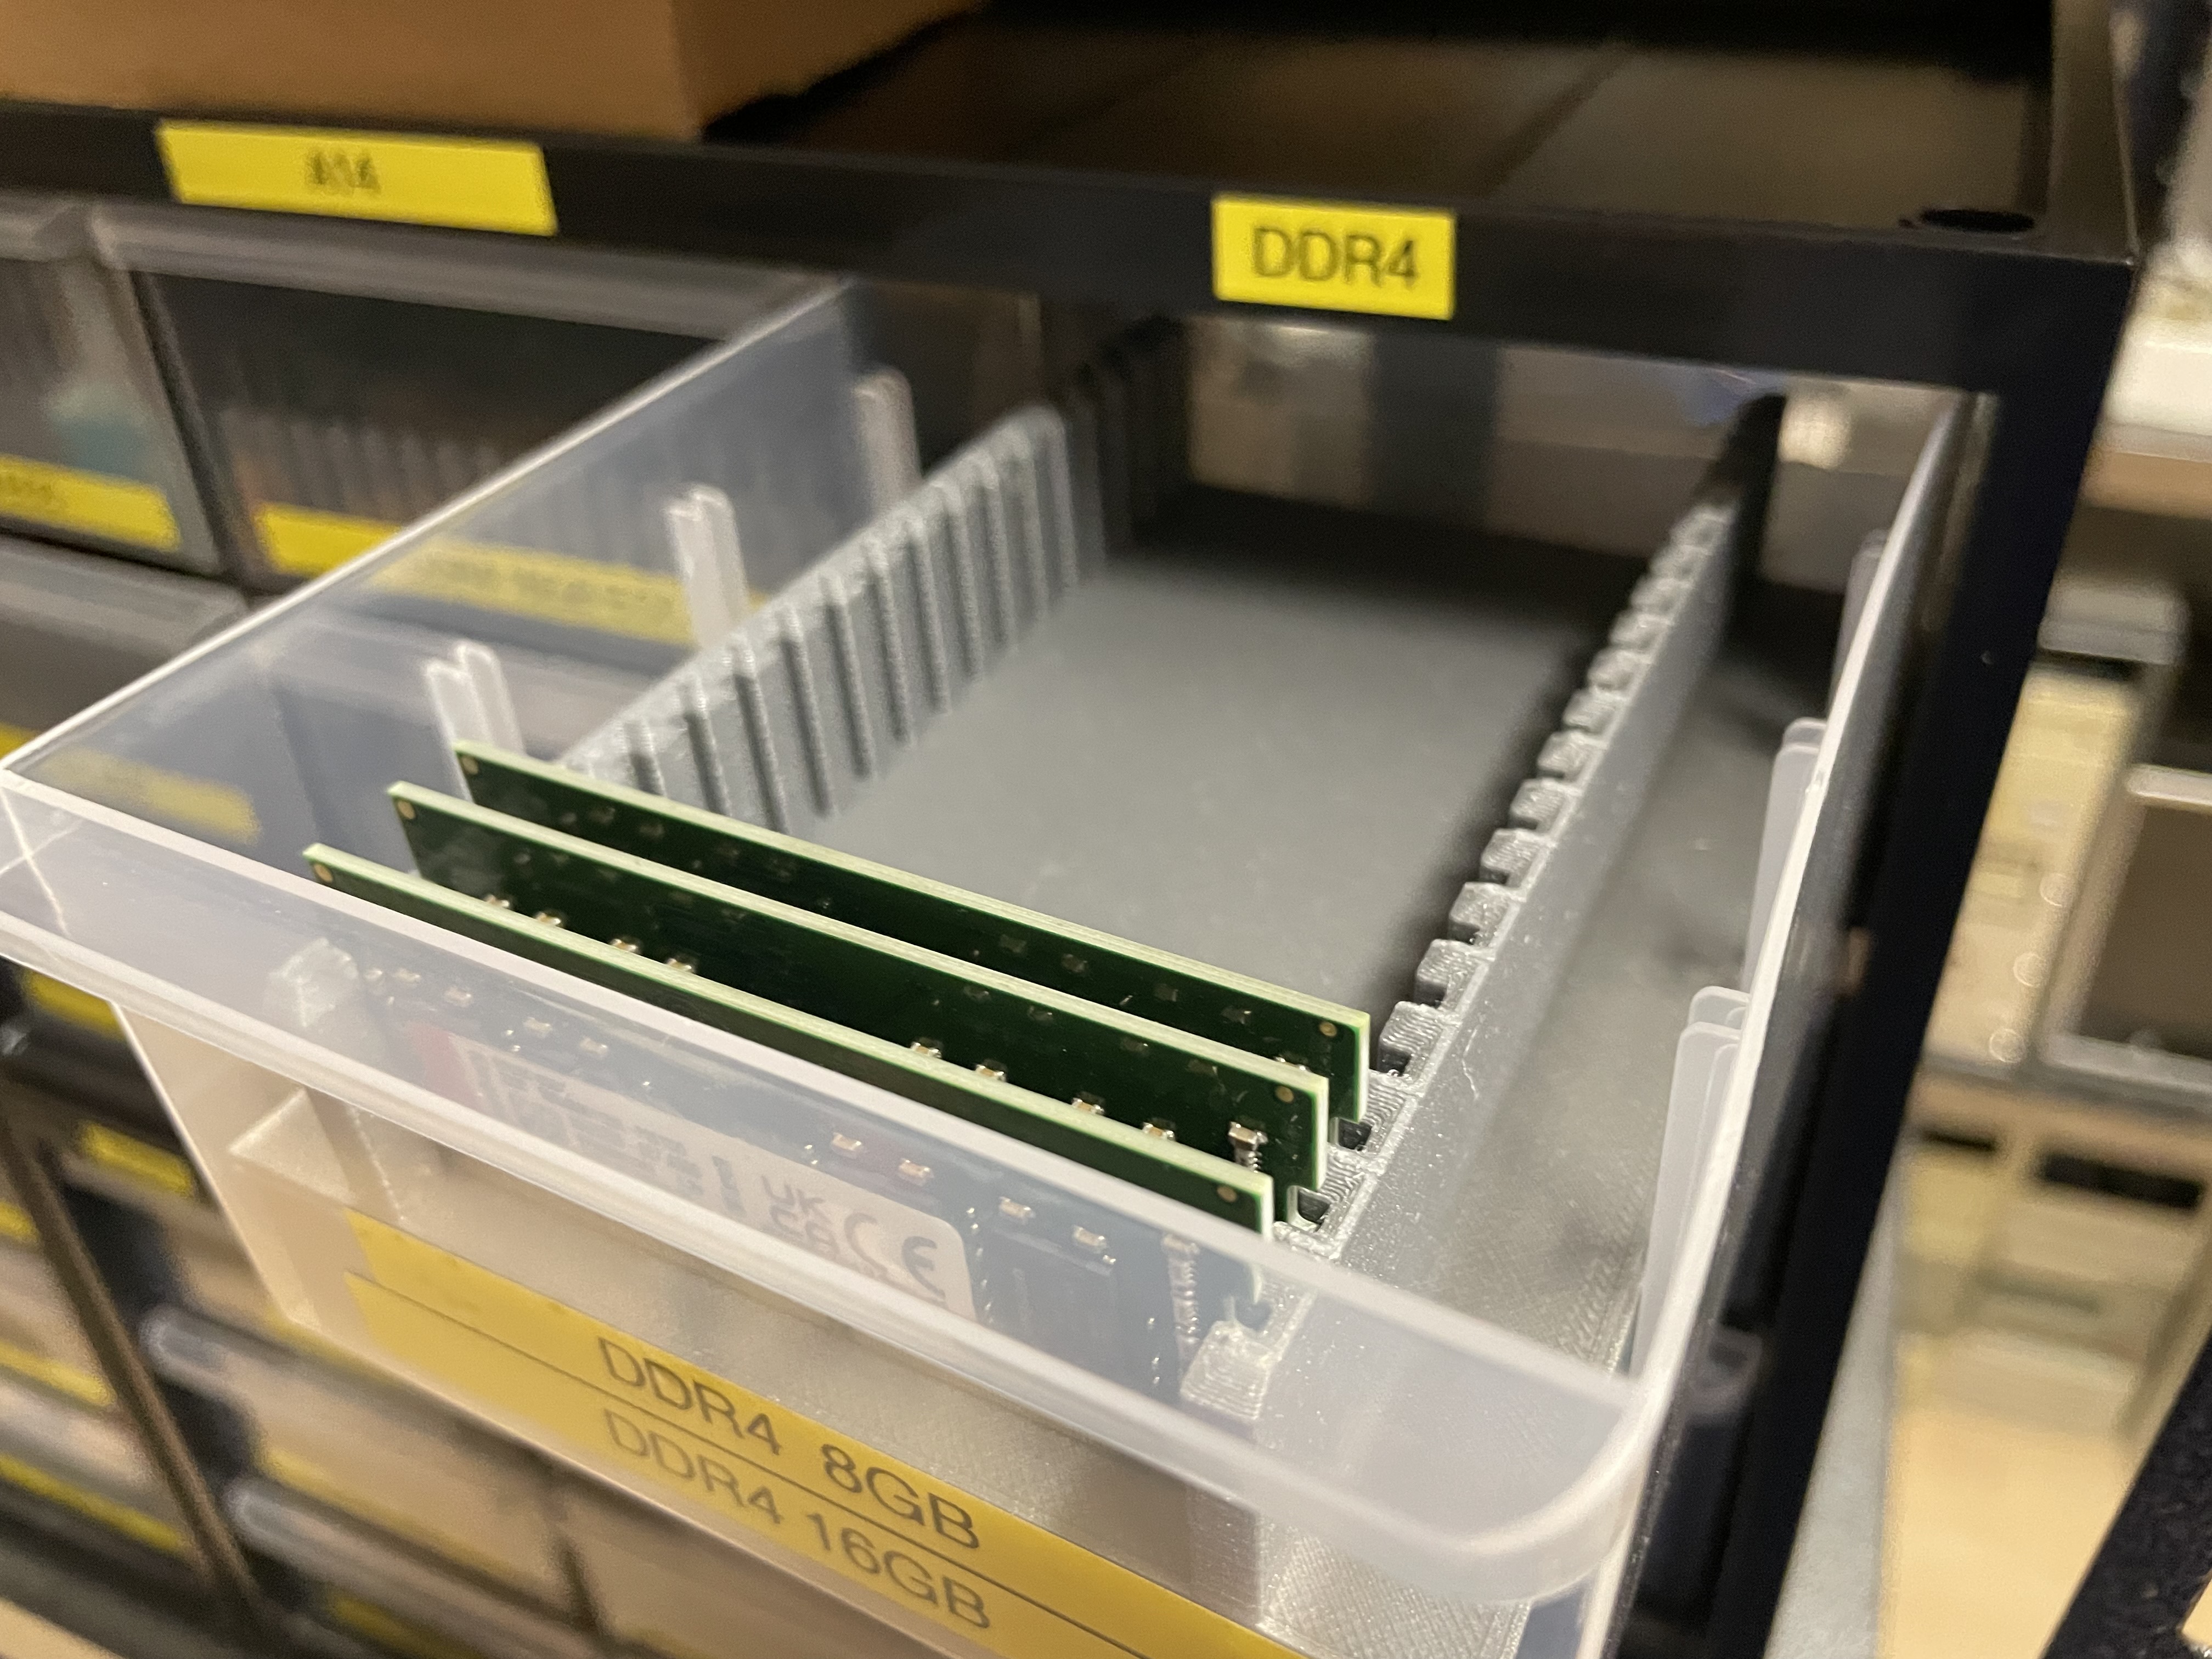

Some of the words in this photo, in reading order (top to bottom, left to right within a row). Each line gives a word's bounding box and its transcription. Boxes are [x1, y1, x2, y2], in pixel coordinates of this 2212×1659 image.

[1252, 226, 1420, 292] DDR4
[598, 1336, 782, 1456] DDR4
[820, 1444, 980, 1549] 8GB
[603, 1408, 783, 1525] DDR4
[806, 1512, 990, 1629] 16GB
